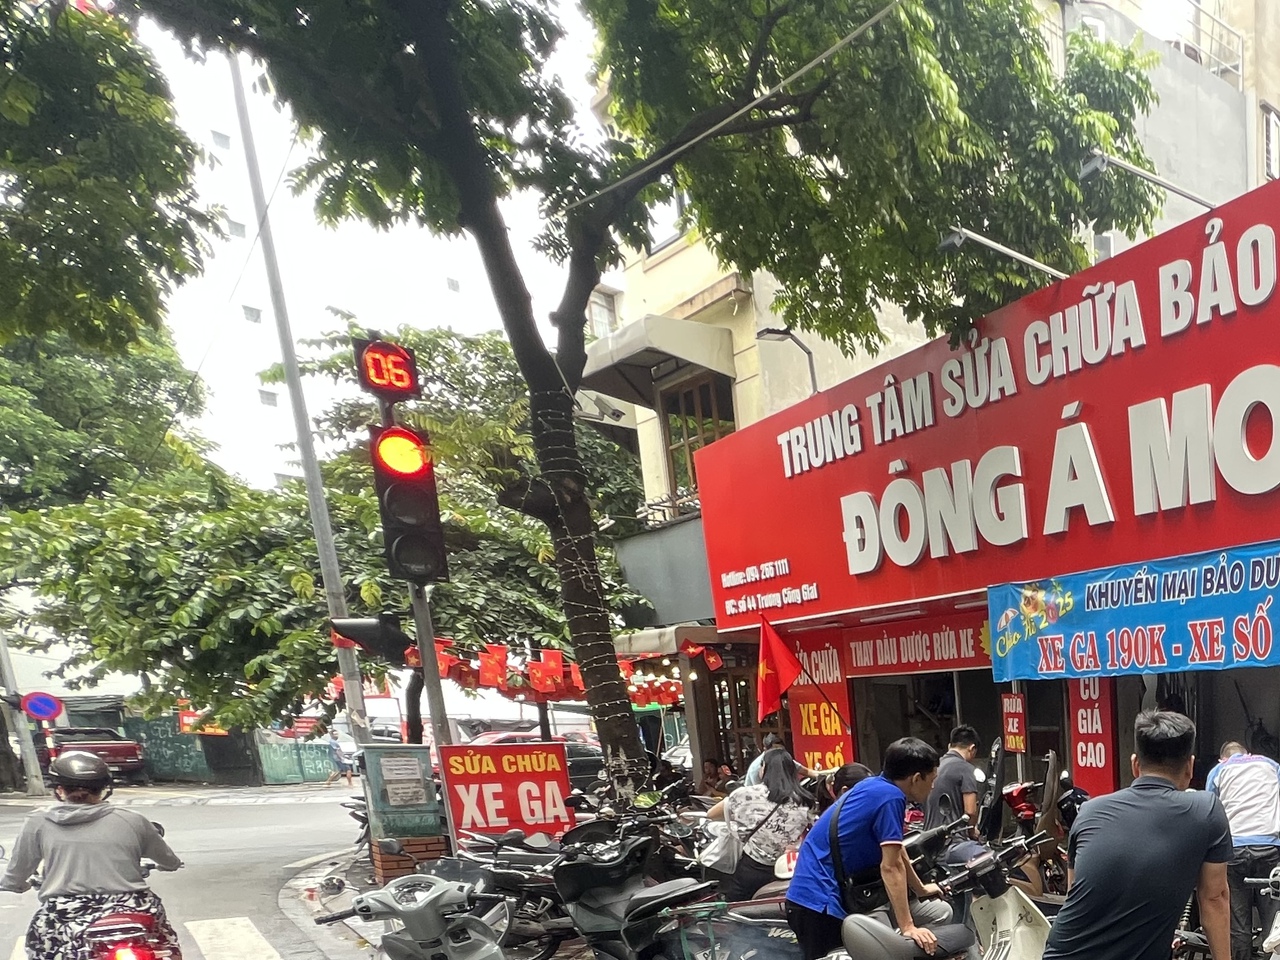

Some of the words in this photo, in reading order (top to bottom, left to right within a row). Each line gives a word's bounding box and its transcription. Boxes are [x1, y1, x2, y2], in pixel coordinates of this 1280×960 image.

[777, 403, 863, 478] TRUNG
[866, 371, 935, 446] TÂM
[940, 327, 1017, 419] SỬA
[1025, 281, 1147, 387] CHỮA
[1158, 217, 1277, 337] BẢO
[365, 351, 411, 389] 06
[840, 444, 1029, 576] ĐÔNG
[1044, 400, 1116, 536] Á
[1085, 566, 1157, 611] KHUYẾN
[1160, 569, 1198, 606] MẠI
[1201, 553, 1246, 596] BẢO
[1039, 590, 1074, 630] 2025
[850, 640, 874, 667] THAY
[932, 624, 958, 661] RỬA
[959, 628, 975, 658] XE
[1036, 633, 1066, 674] XE
[1068, 630, 1102, 672] GA
[1106, 623, 1167, 669] 190K
[1188, 618, 1225, 665] XE
[1232, 596, 1274, 661] SỐ
[799, 703, 819, 736] XE
[820, 702, 842, 736] GA
[1007, 717, 1019, 733] XE
[1077, 702, 1102, 734] GIÁ
[449, 749, 497, 776] SỬA
[502, 750, 562, 774] CHỮA
[1076, 741, 1106, 768] CAO
[454, 783, 509, 829] XE
[517, 781, 570, 826] GA
